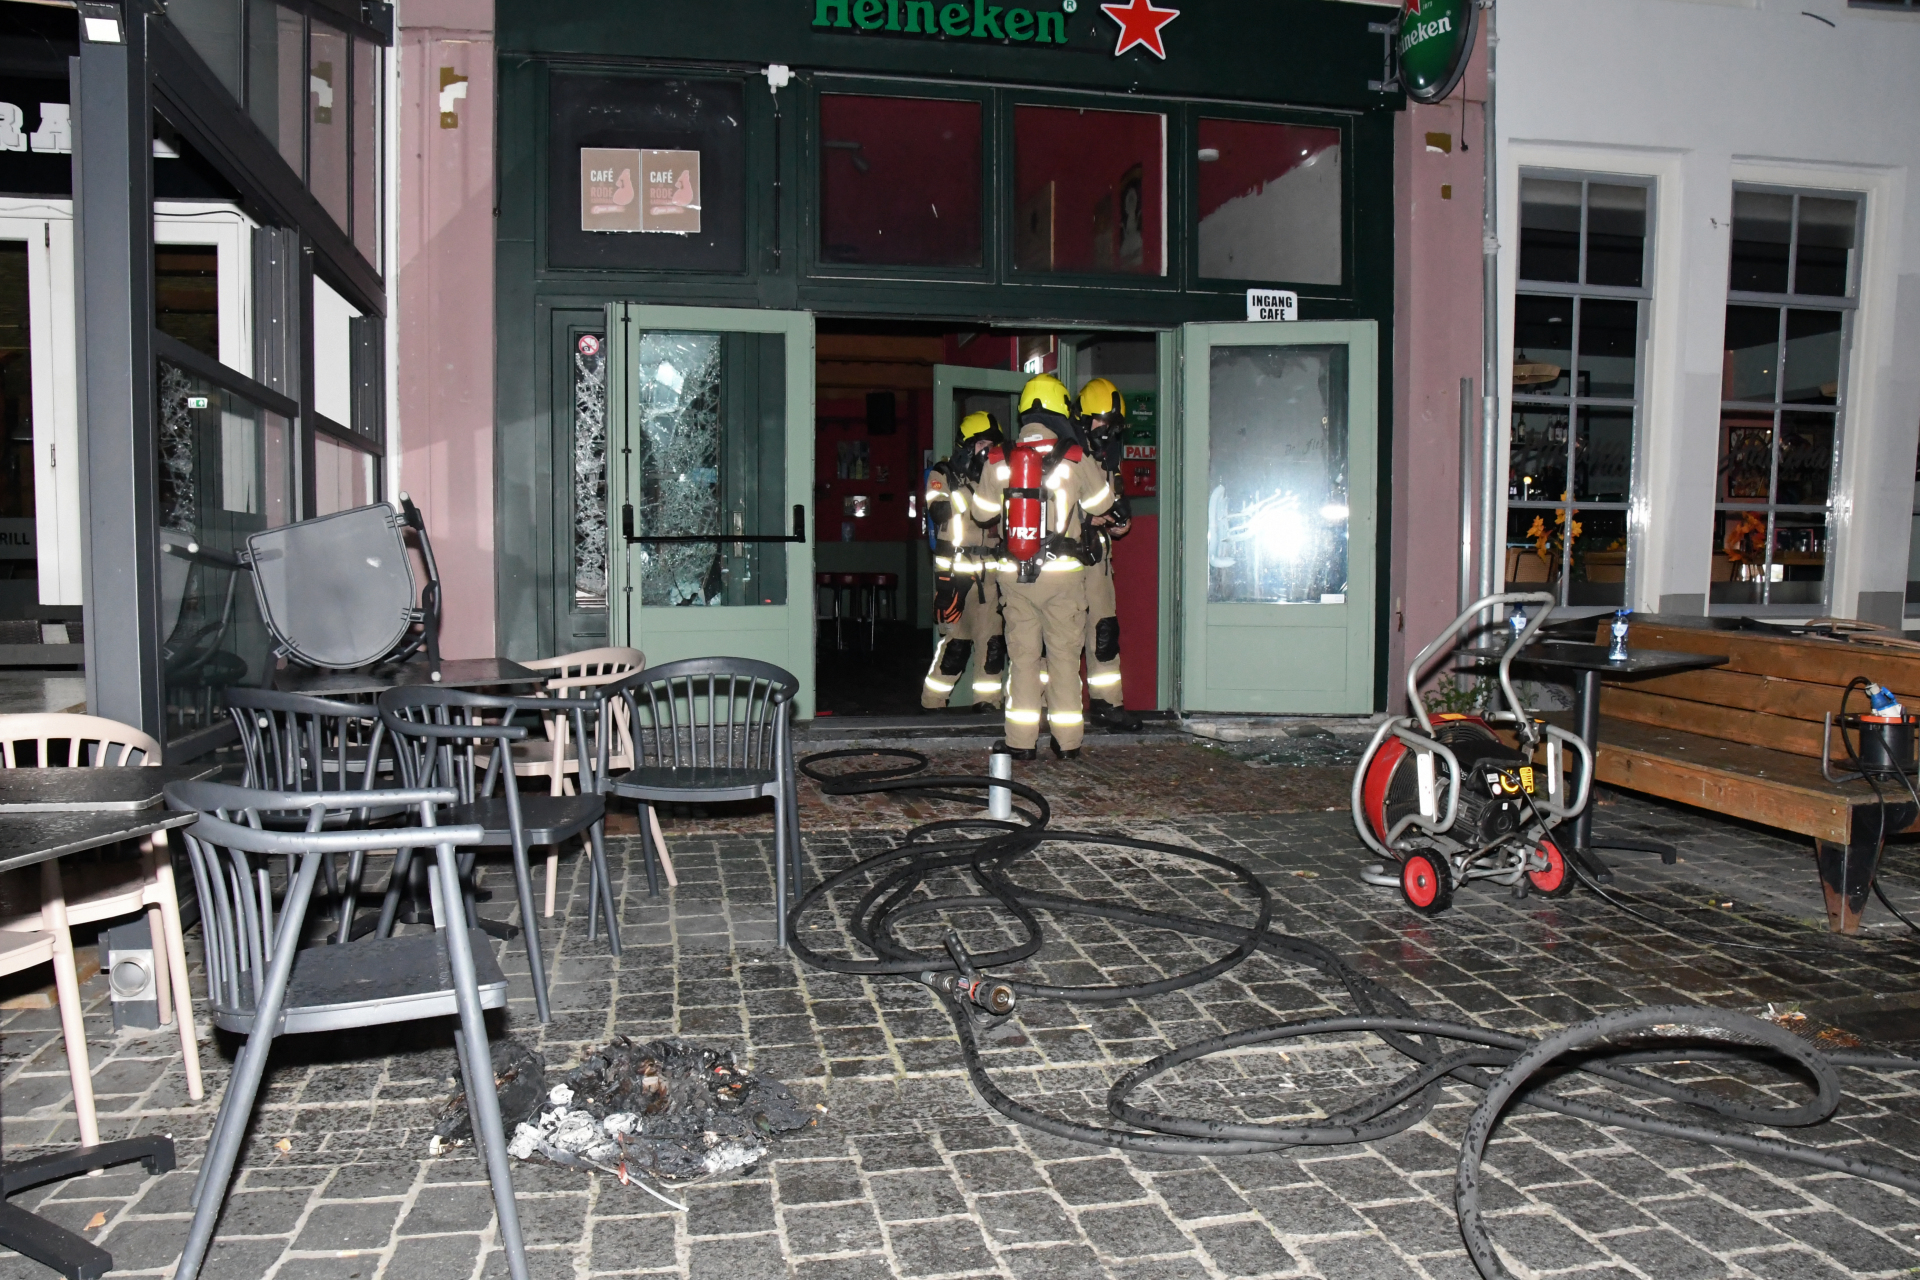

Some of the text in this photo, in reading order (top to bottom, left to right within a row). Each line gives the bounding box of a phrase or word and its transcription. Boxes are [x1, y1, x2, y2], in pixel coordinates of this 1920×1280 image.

[812, 0, 1068, 44] Heineken
[1401, 16, 1452, 54] ineken
[590, 168, 613, 182] CAFÉ
[650, 169, 673, 183] CAFÉ
[590, 187, 613, 198] RODE
[650, 188, 673, 199] RODE
[1252, 295, 1292, 308] INGANG
[1260, 308, 1286, 321] CAFE
[1009, 526, 1038, 540] VRZ
